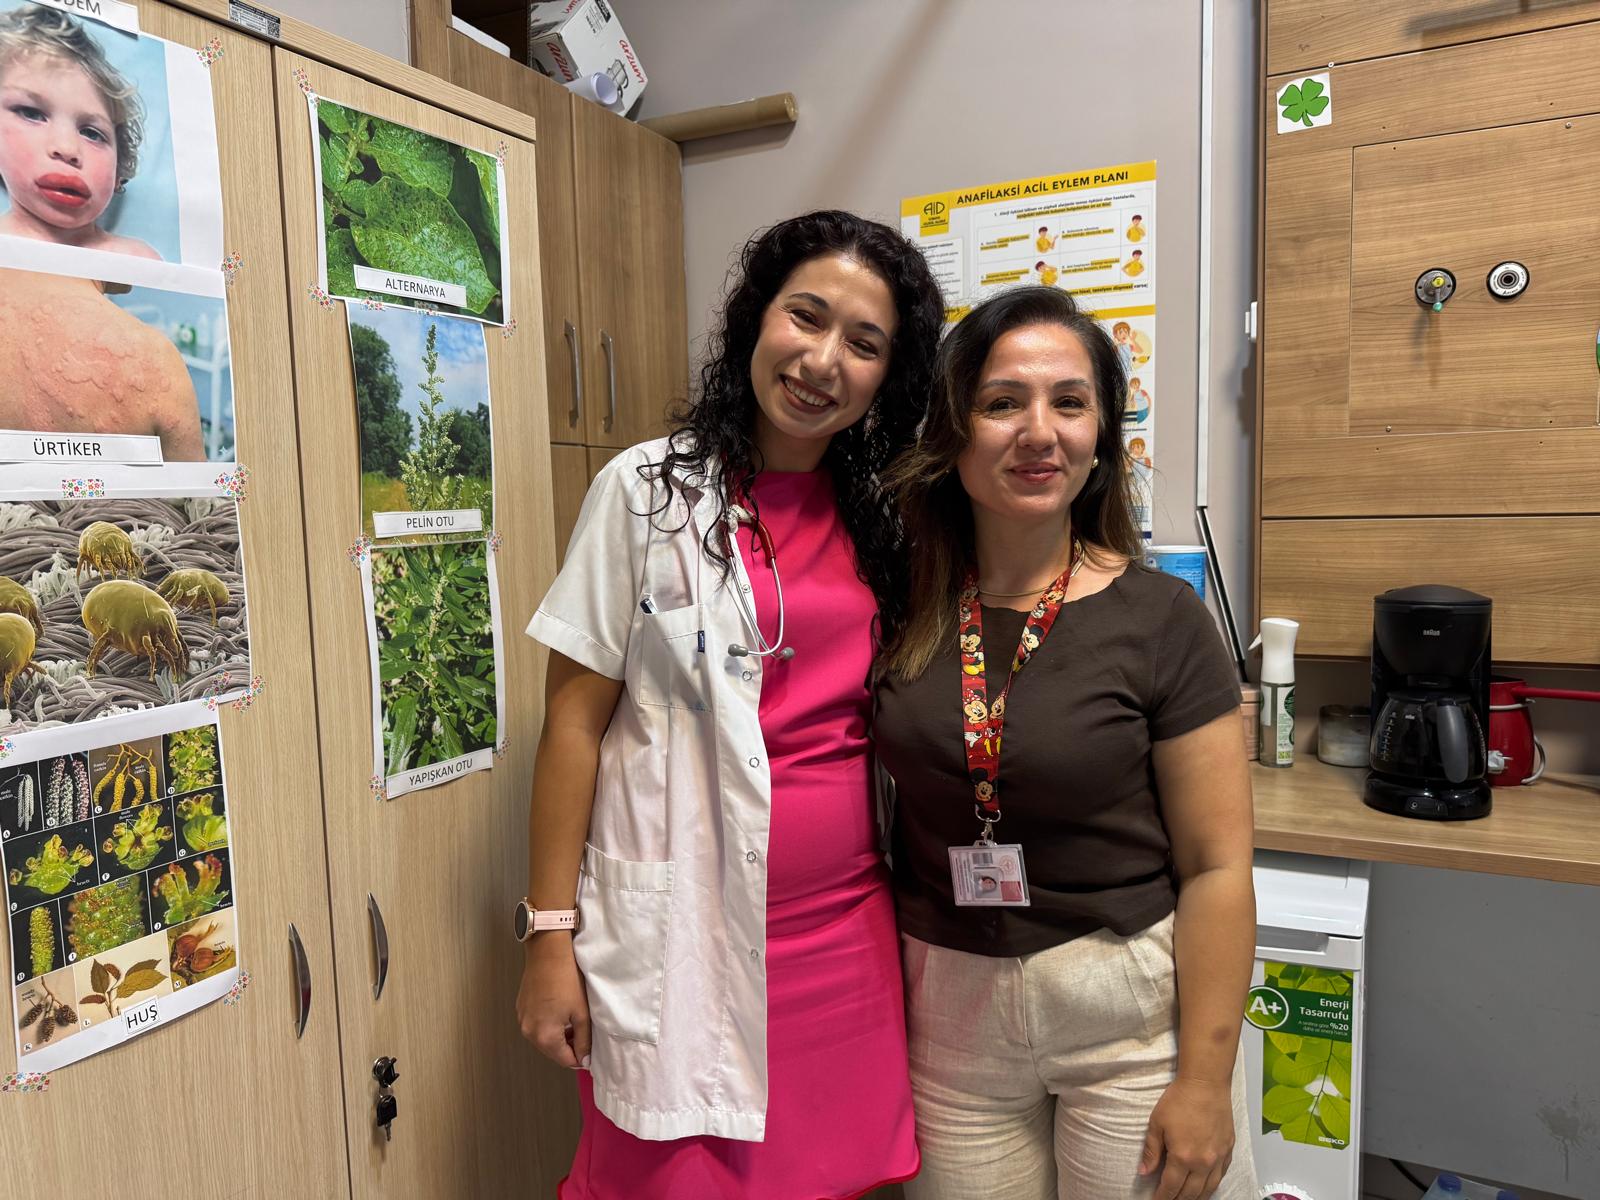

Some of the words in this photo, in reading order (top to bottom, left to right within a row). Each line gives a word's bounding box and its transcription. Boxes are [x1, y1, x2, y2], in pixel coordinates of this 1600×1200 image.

[53, 0, 101, 16] EM
[618, 39, 645, 83] arzum
[956, 186, 1020, 205] ANAFİLAKSİ
[1023, 181, 1049, 194] ACİL
[1052, 176, 1090, 190] EYLEM
[1093, 171, 1129, 184] PLANI
[385, 278, 446, 298] ALTERNARYA
[33, 438, 102, 456] ÜRTİKER
[406, 515, 433, 529] PELİN
[436, 516, 455, 527] OTU
[408, 764, 454, 786] YAPIŞKAN
[455, 758, 473, 772] OTU
[1249, 996, 1282, 1015] A+
[1320, 998, 1349, 1010] Enerji
[127, 1004, 158, 1029] HUŞ
[1299, 1007, 1349, 1020] Tasarrufu
[1329, 1022, 1349, 1031] %20
